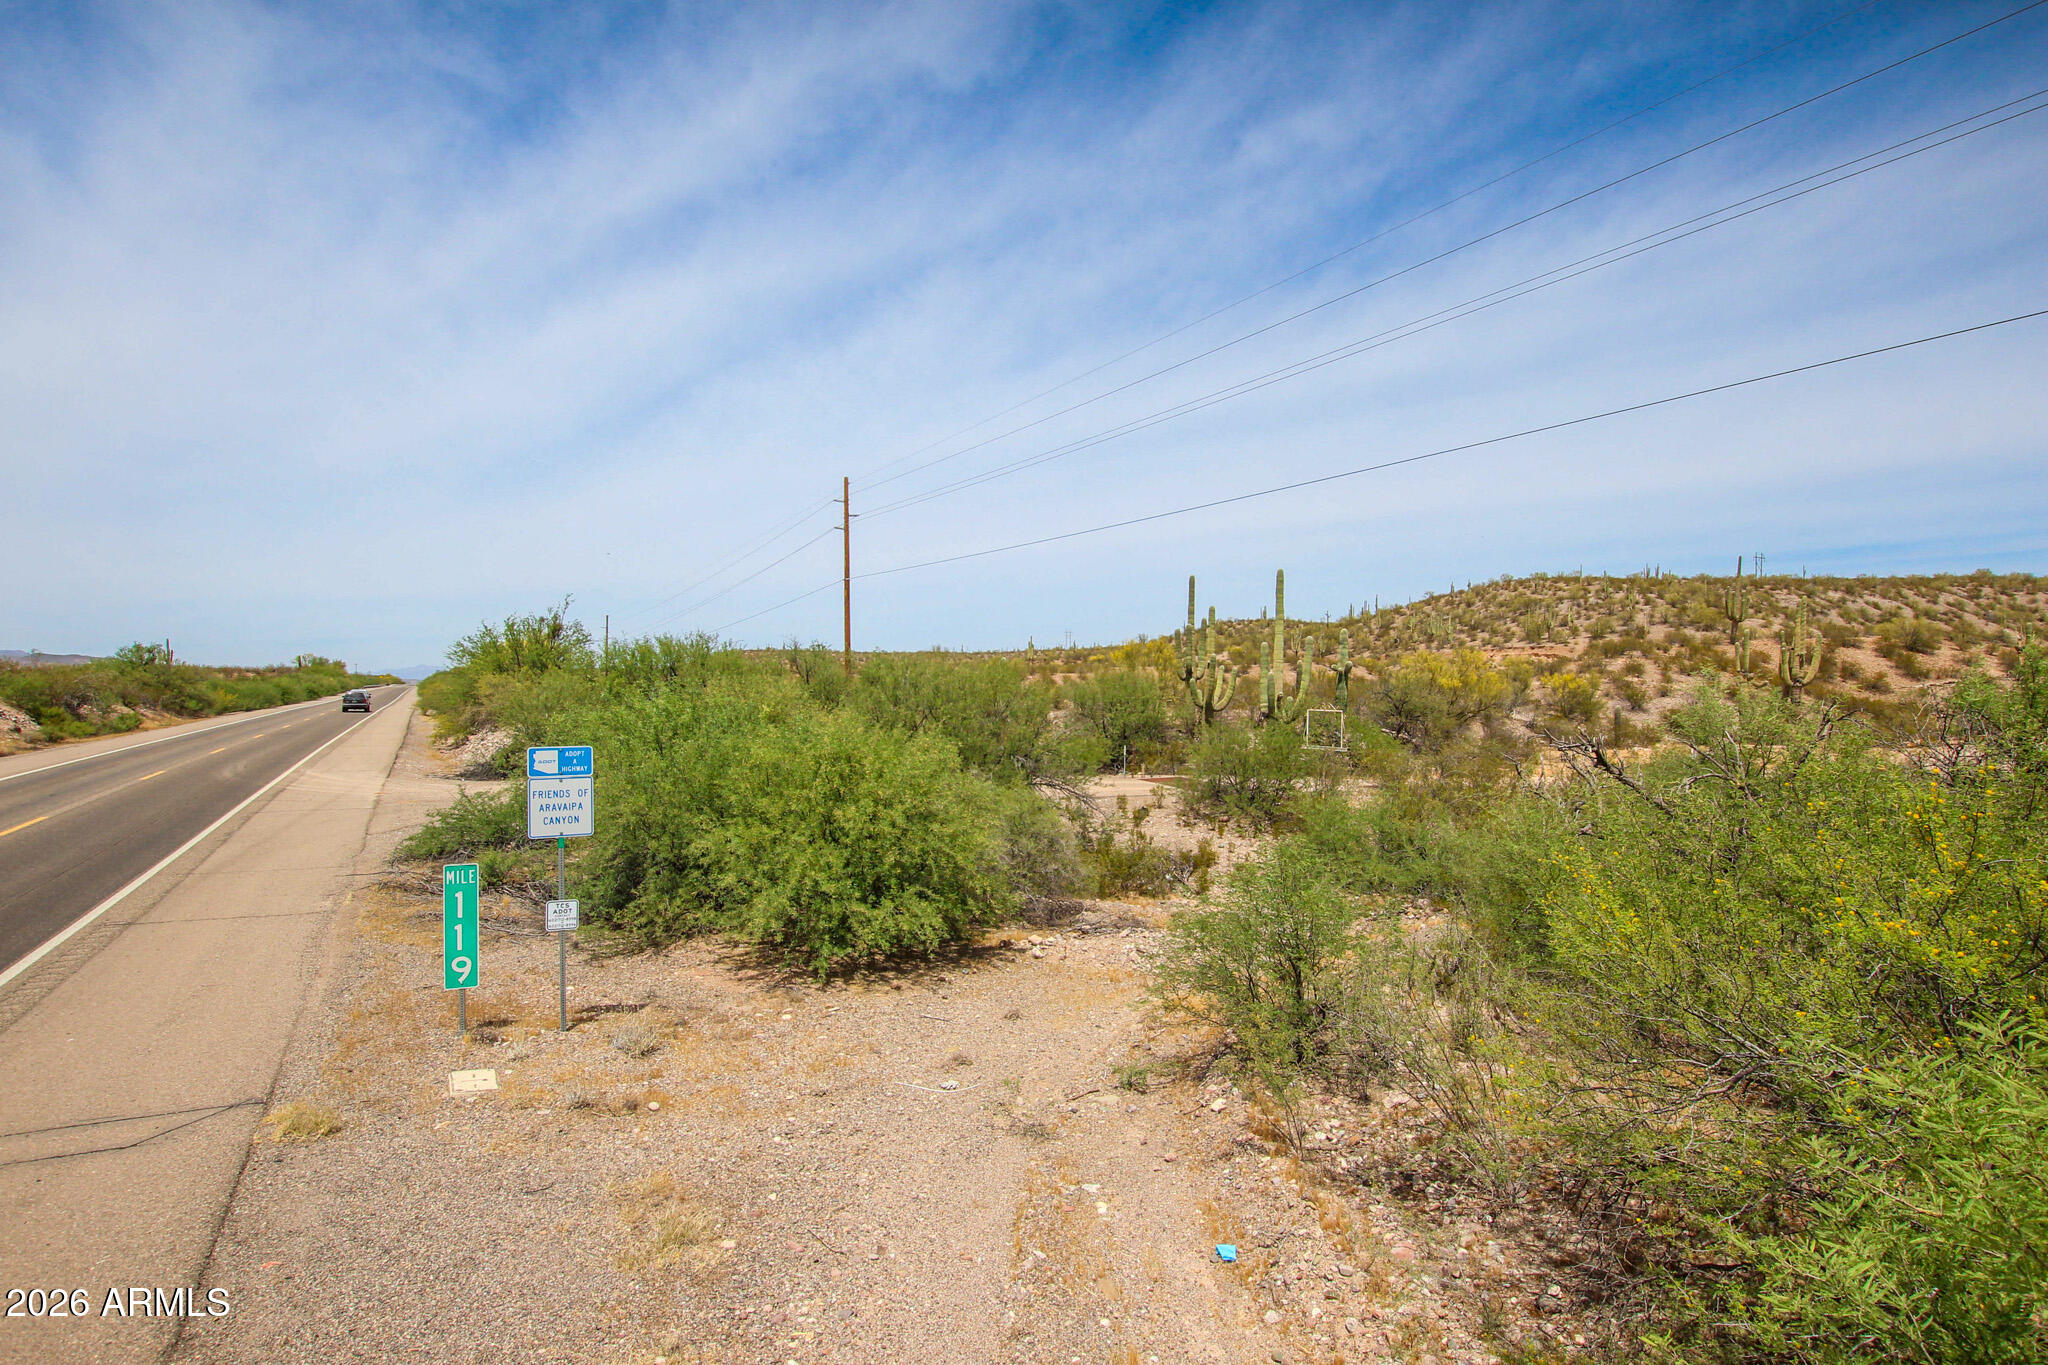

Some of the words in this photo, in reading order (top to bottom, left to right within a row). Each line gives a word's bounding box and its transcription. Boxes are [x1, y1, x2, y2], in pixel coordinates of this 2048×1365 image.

[532, 789, 571, 799] FRIENDS
[577, 788, 589, 798] OF
[539, 802, 584, 812] ARAVAIPA
[543, 815, 580, 825] CANYON
[446, 869, 476, 885] MILE
[451, 891, 472, 985] 119
